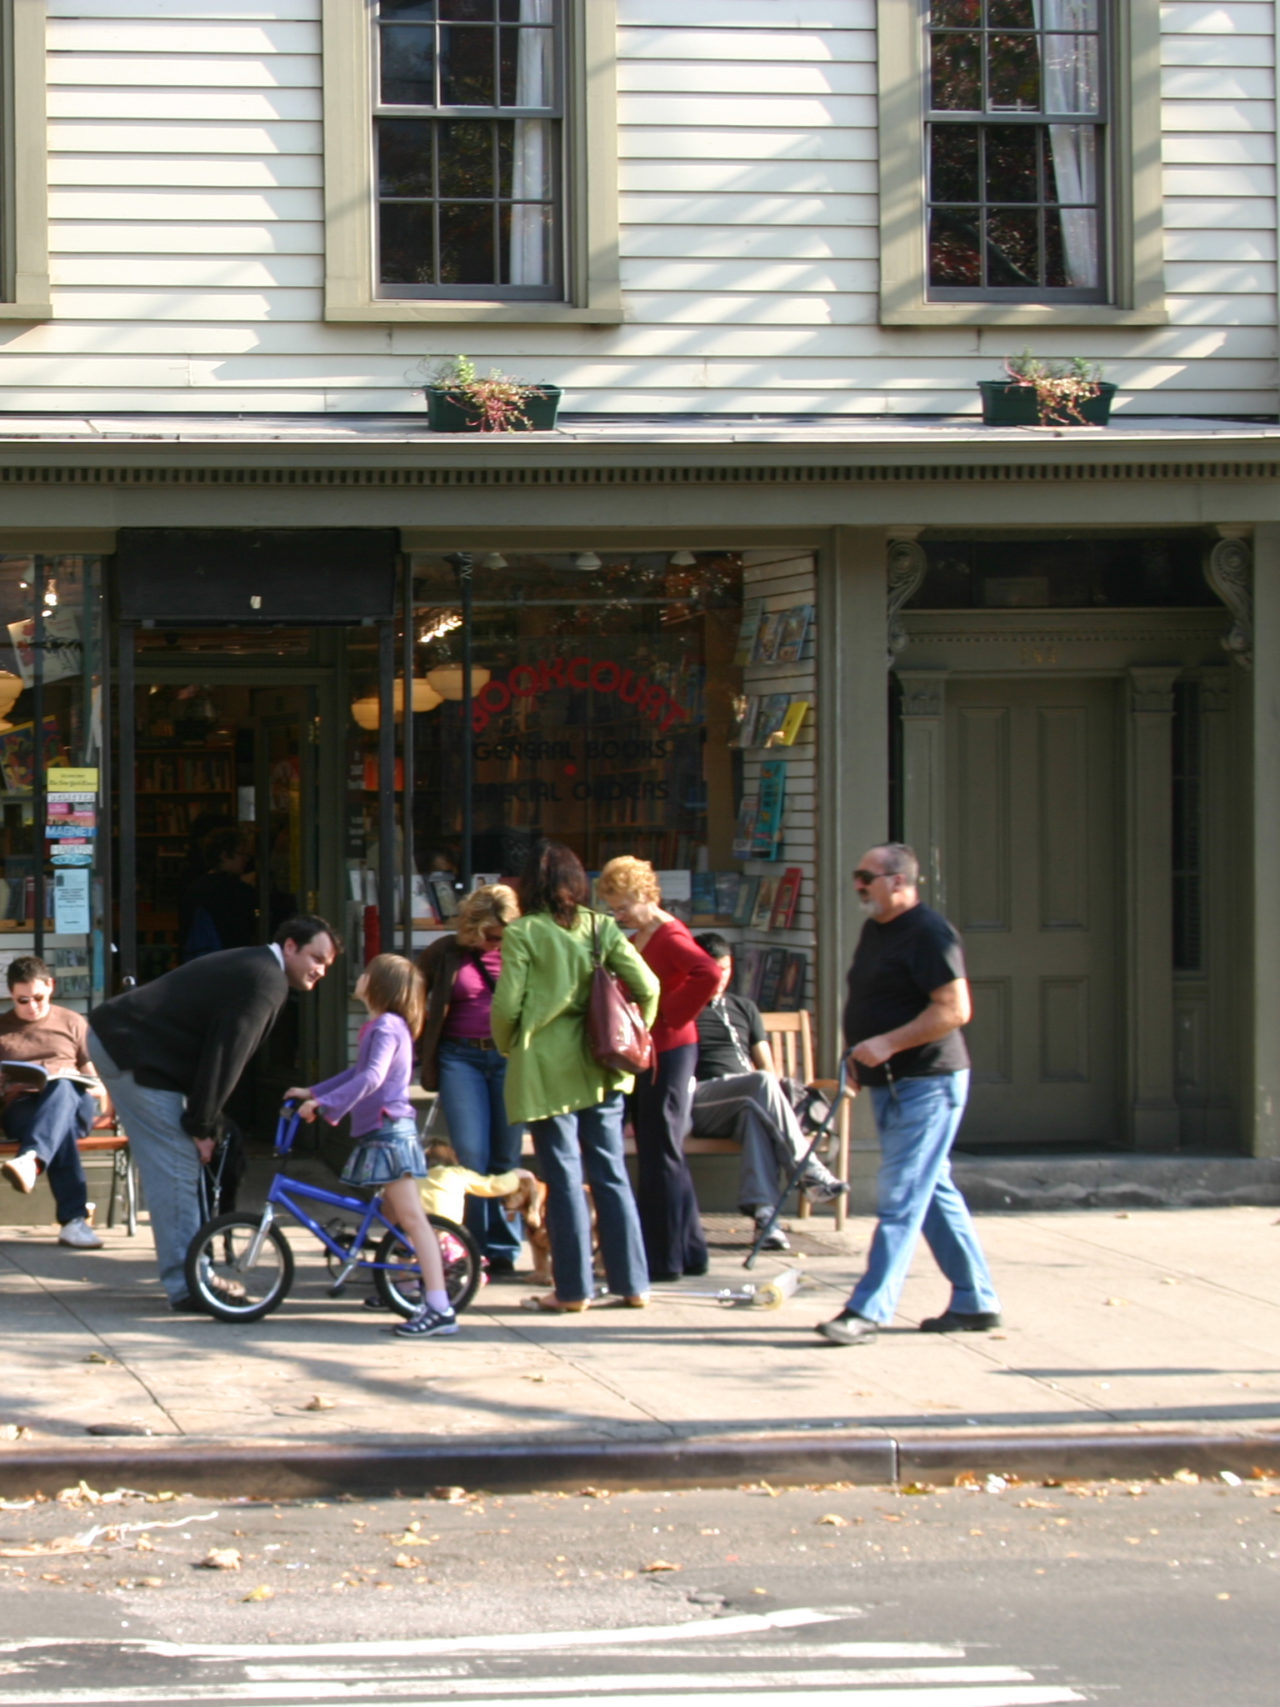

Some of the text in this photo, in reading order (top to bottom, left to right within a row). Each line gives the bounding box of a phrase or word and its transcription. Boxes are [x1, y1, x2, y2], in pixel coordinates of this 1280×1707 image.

[458, 656, 688, 732] BOOKCOURT
[473, 739, 667, 761] GENERAL BOOKS
